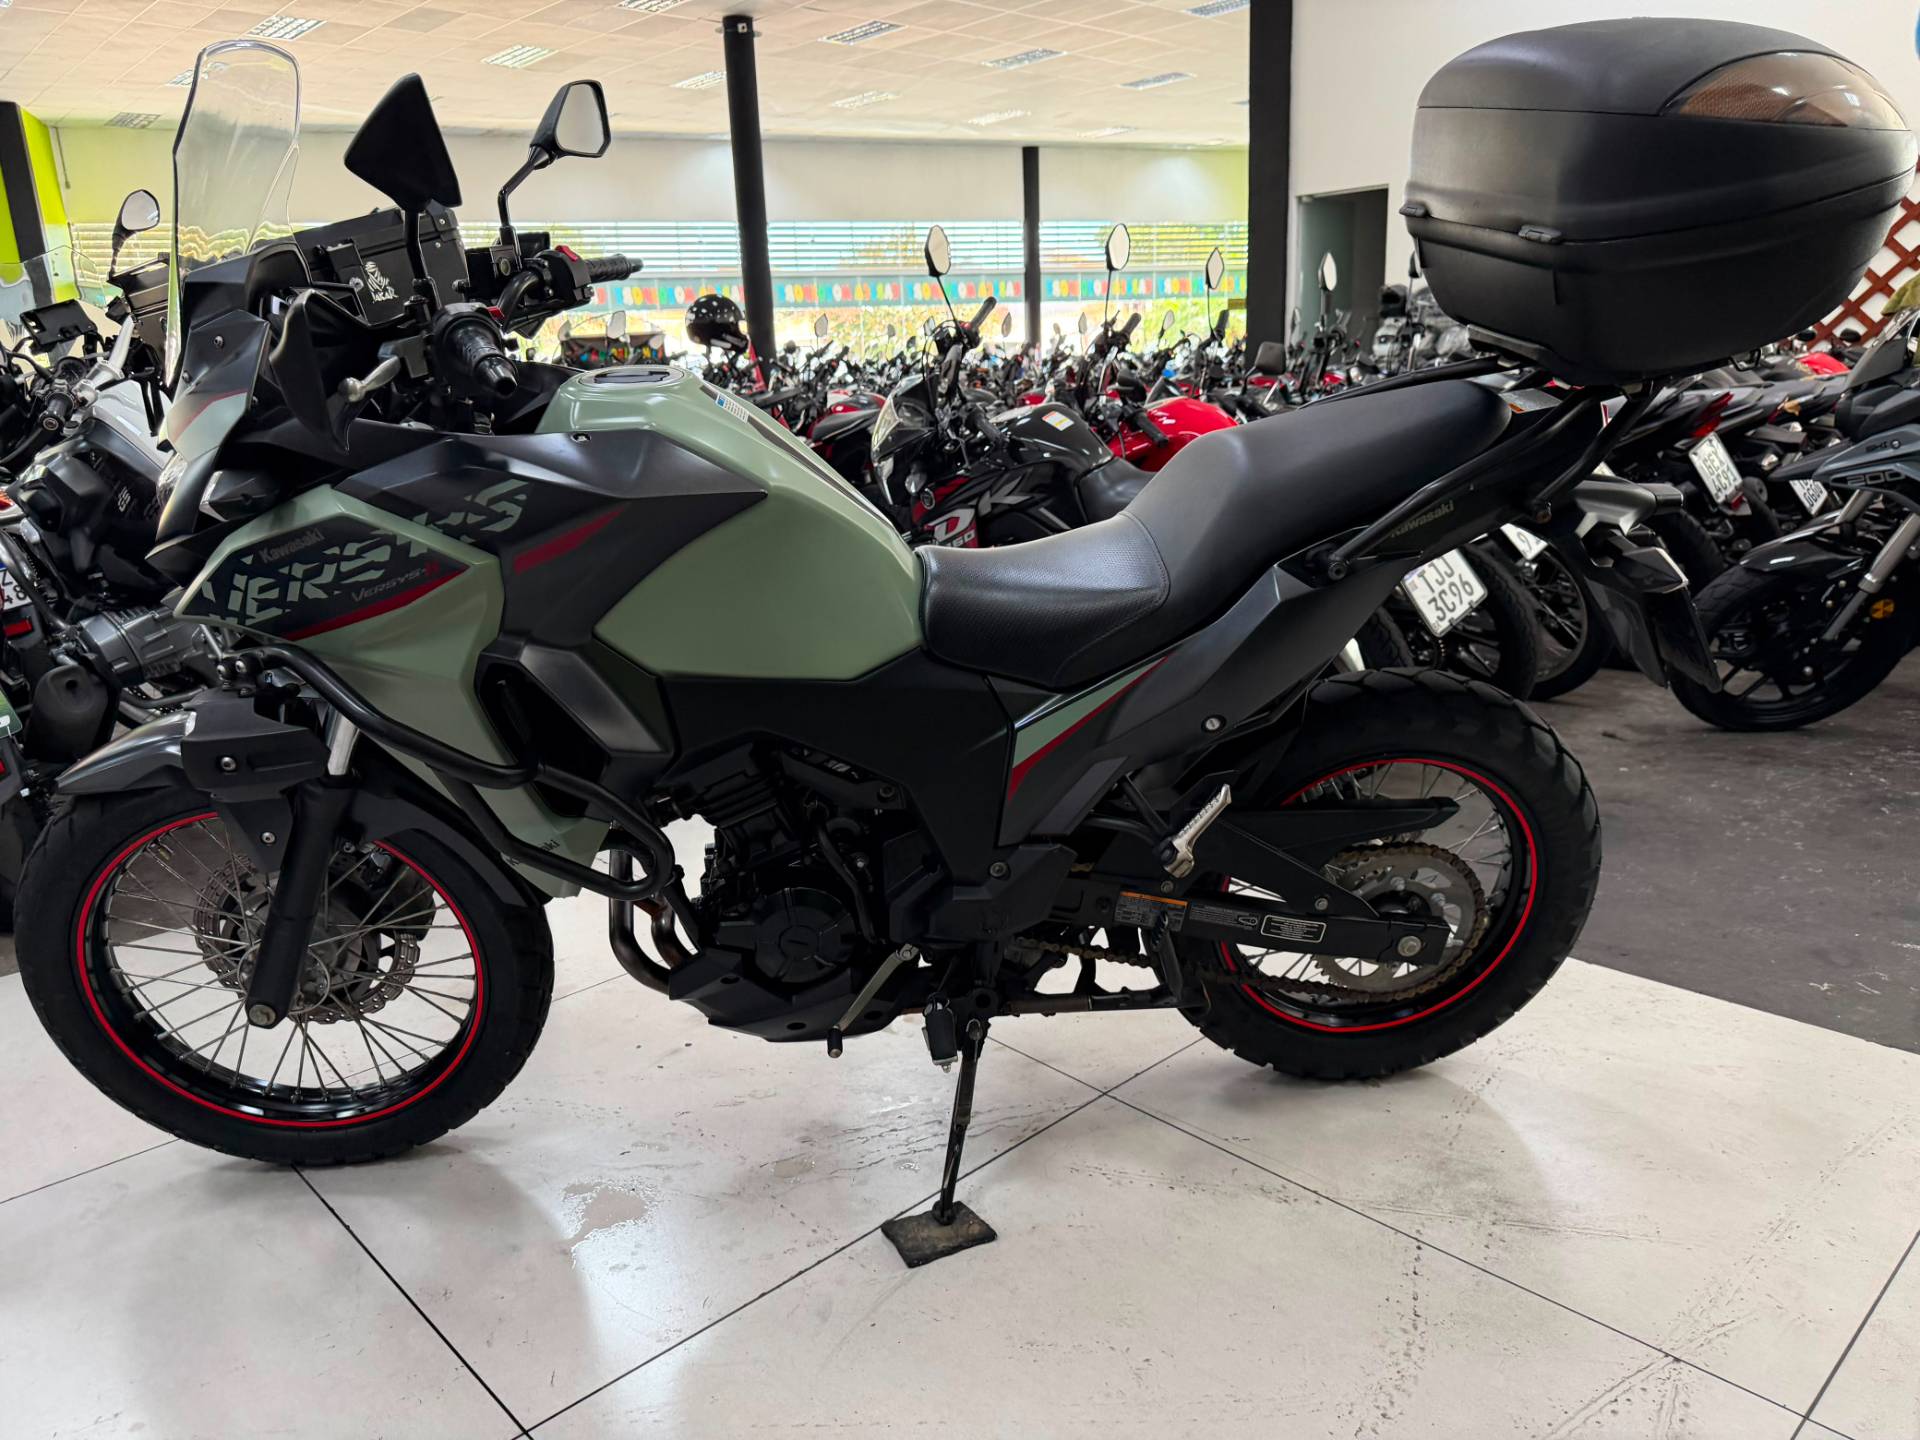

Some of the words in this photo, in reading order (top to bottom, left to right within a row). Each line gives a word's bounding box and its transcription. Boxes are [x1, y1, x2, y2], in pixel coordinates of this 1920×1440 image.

[1846, 470, 1906, 487] 200
[258, 528, 325, 565] Kawasaki
[1427, 574, 1475, 622] 3C96
